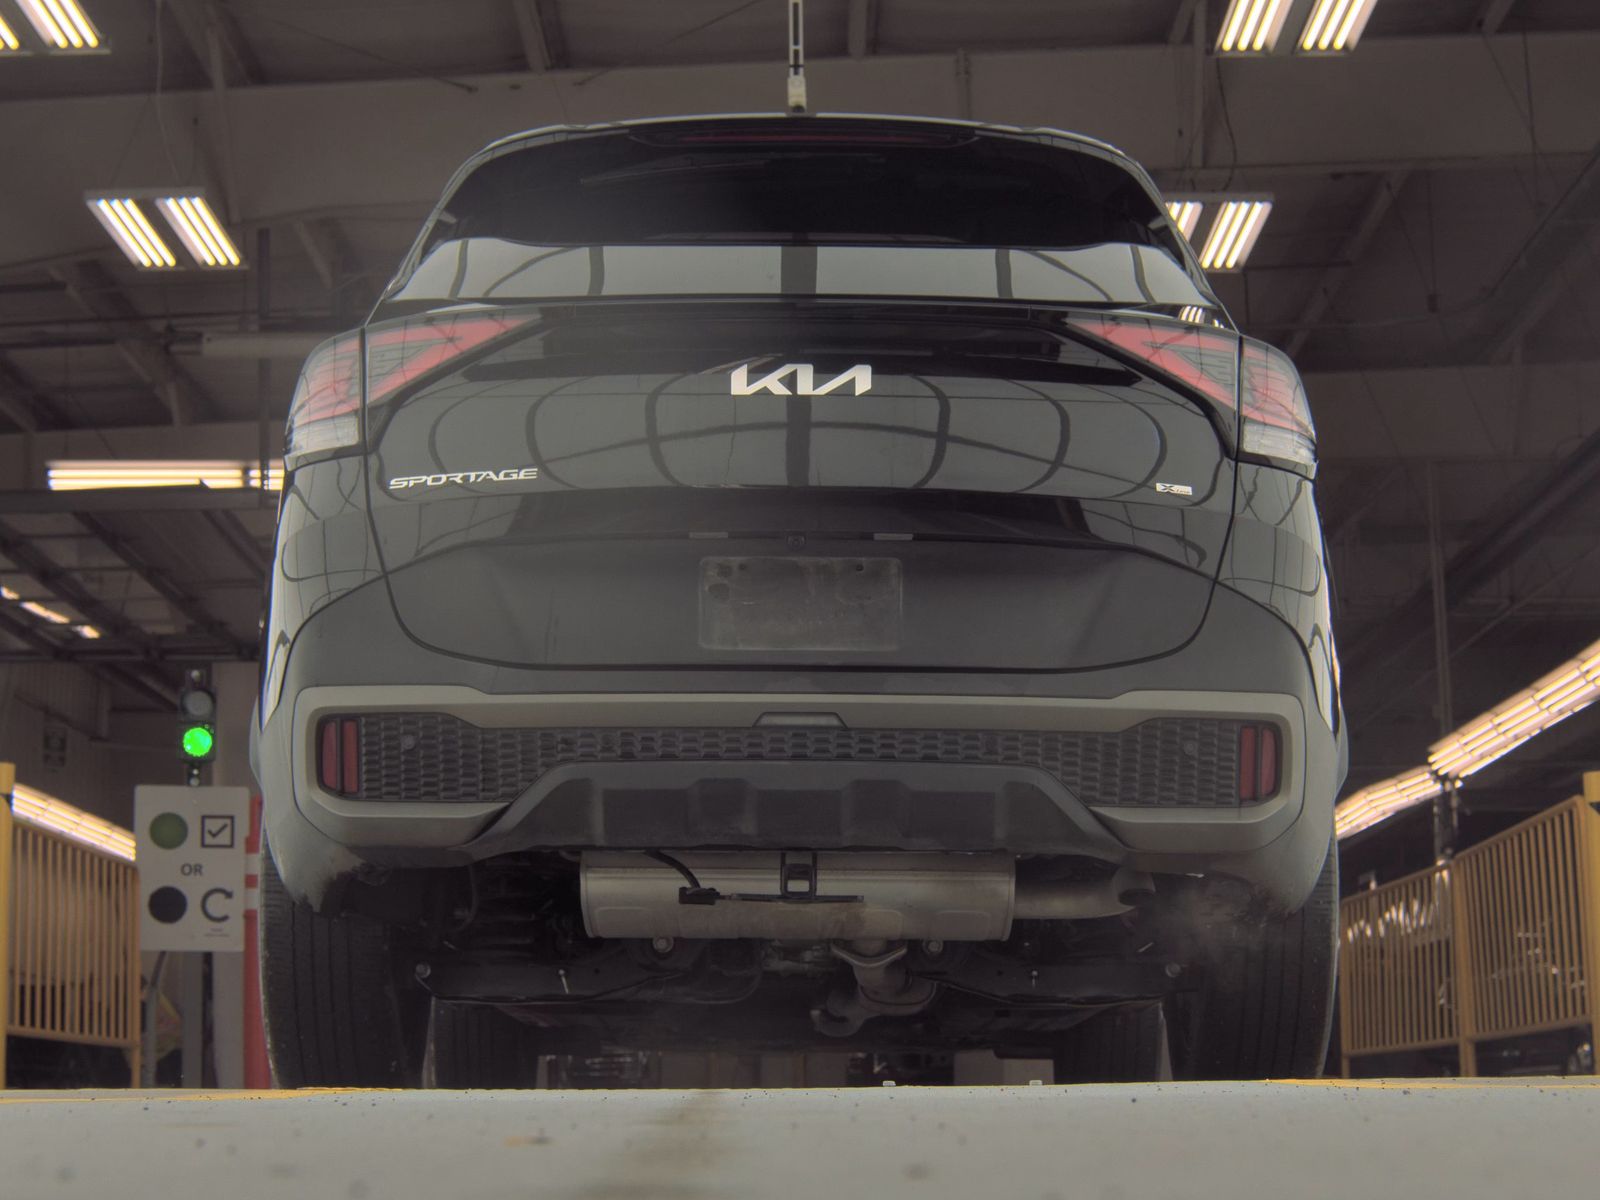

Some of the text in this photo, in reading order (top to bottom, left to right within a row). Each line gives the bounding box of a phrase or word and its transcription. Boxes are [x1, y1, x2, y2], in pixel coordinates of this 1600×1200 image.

[730, 363, 872, 396] KIA
[388, 467, 539, 490] SPORTAGE
[180, 863, 203, 876] OR
